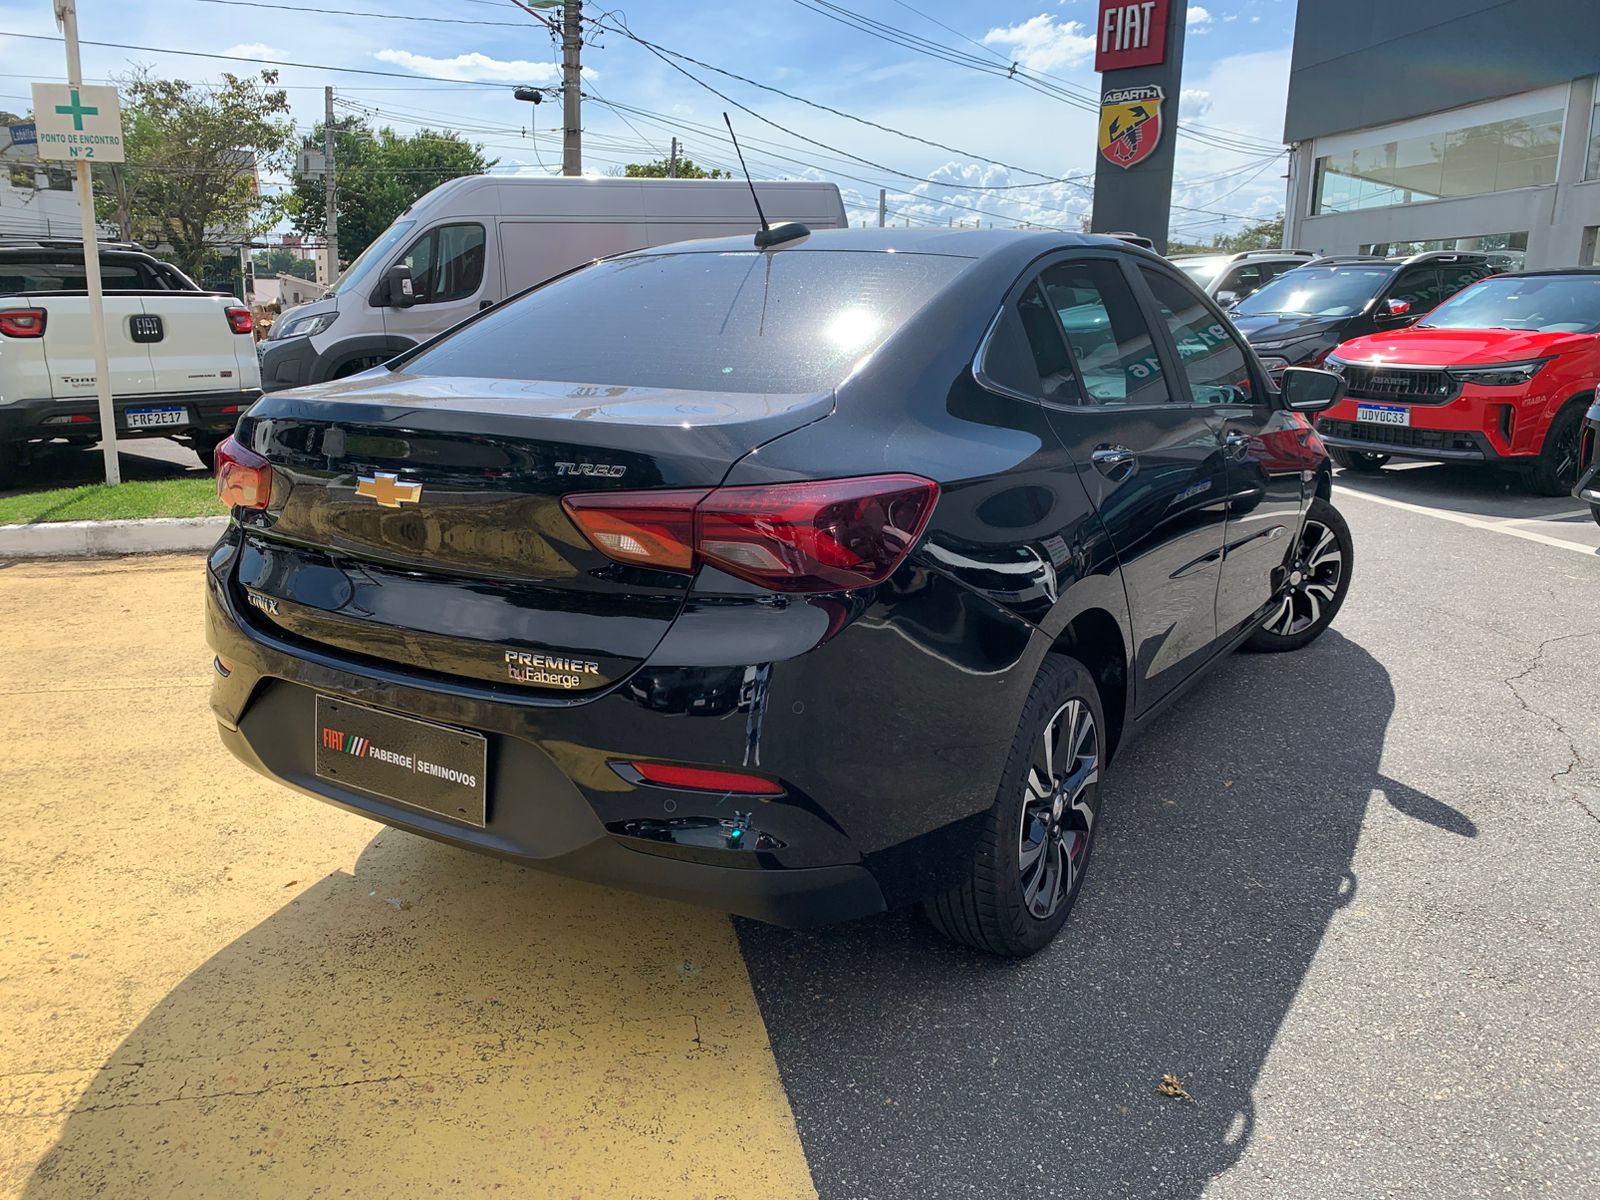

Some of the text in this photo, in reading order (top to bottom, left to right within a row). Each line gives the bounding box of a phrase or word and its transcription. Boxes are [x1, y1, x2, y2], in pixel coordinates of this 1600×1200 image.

[1102, 2, 1156, 53] FIAT
[1104, 89, 1157, 103] ABARTH
[41, 133, 66, 143] PONTO
[67, 134, 78, 144] DE
[80, 134, 120, 145] ENCONTRO
[85, 146, 95, 157] 2
[136, 317, 159, 335] FIAT
[554, 461, 627, 478] TURBO
[504, 650, 600, 675] PREMIER
[323, 727, 476, 788] FIAT FABERGE SEMINOVOS
